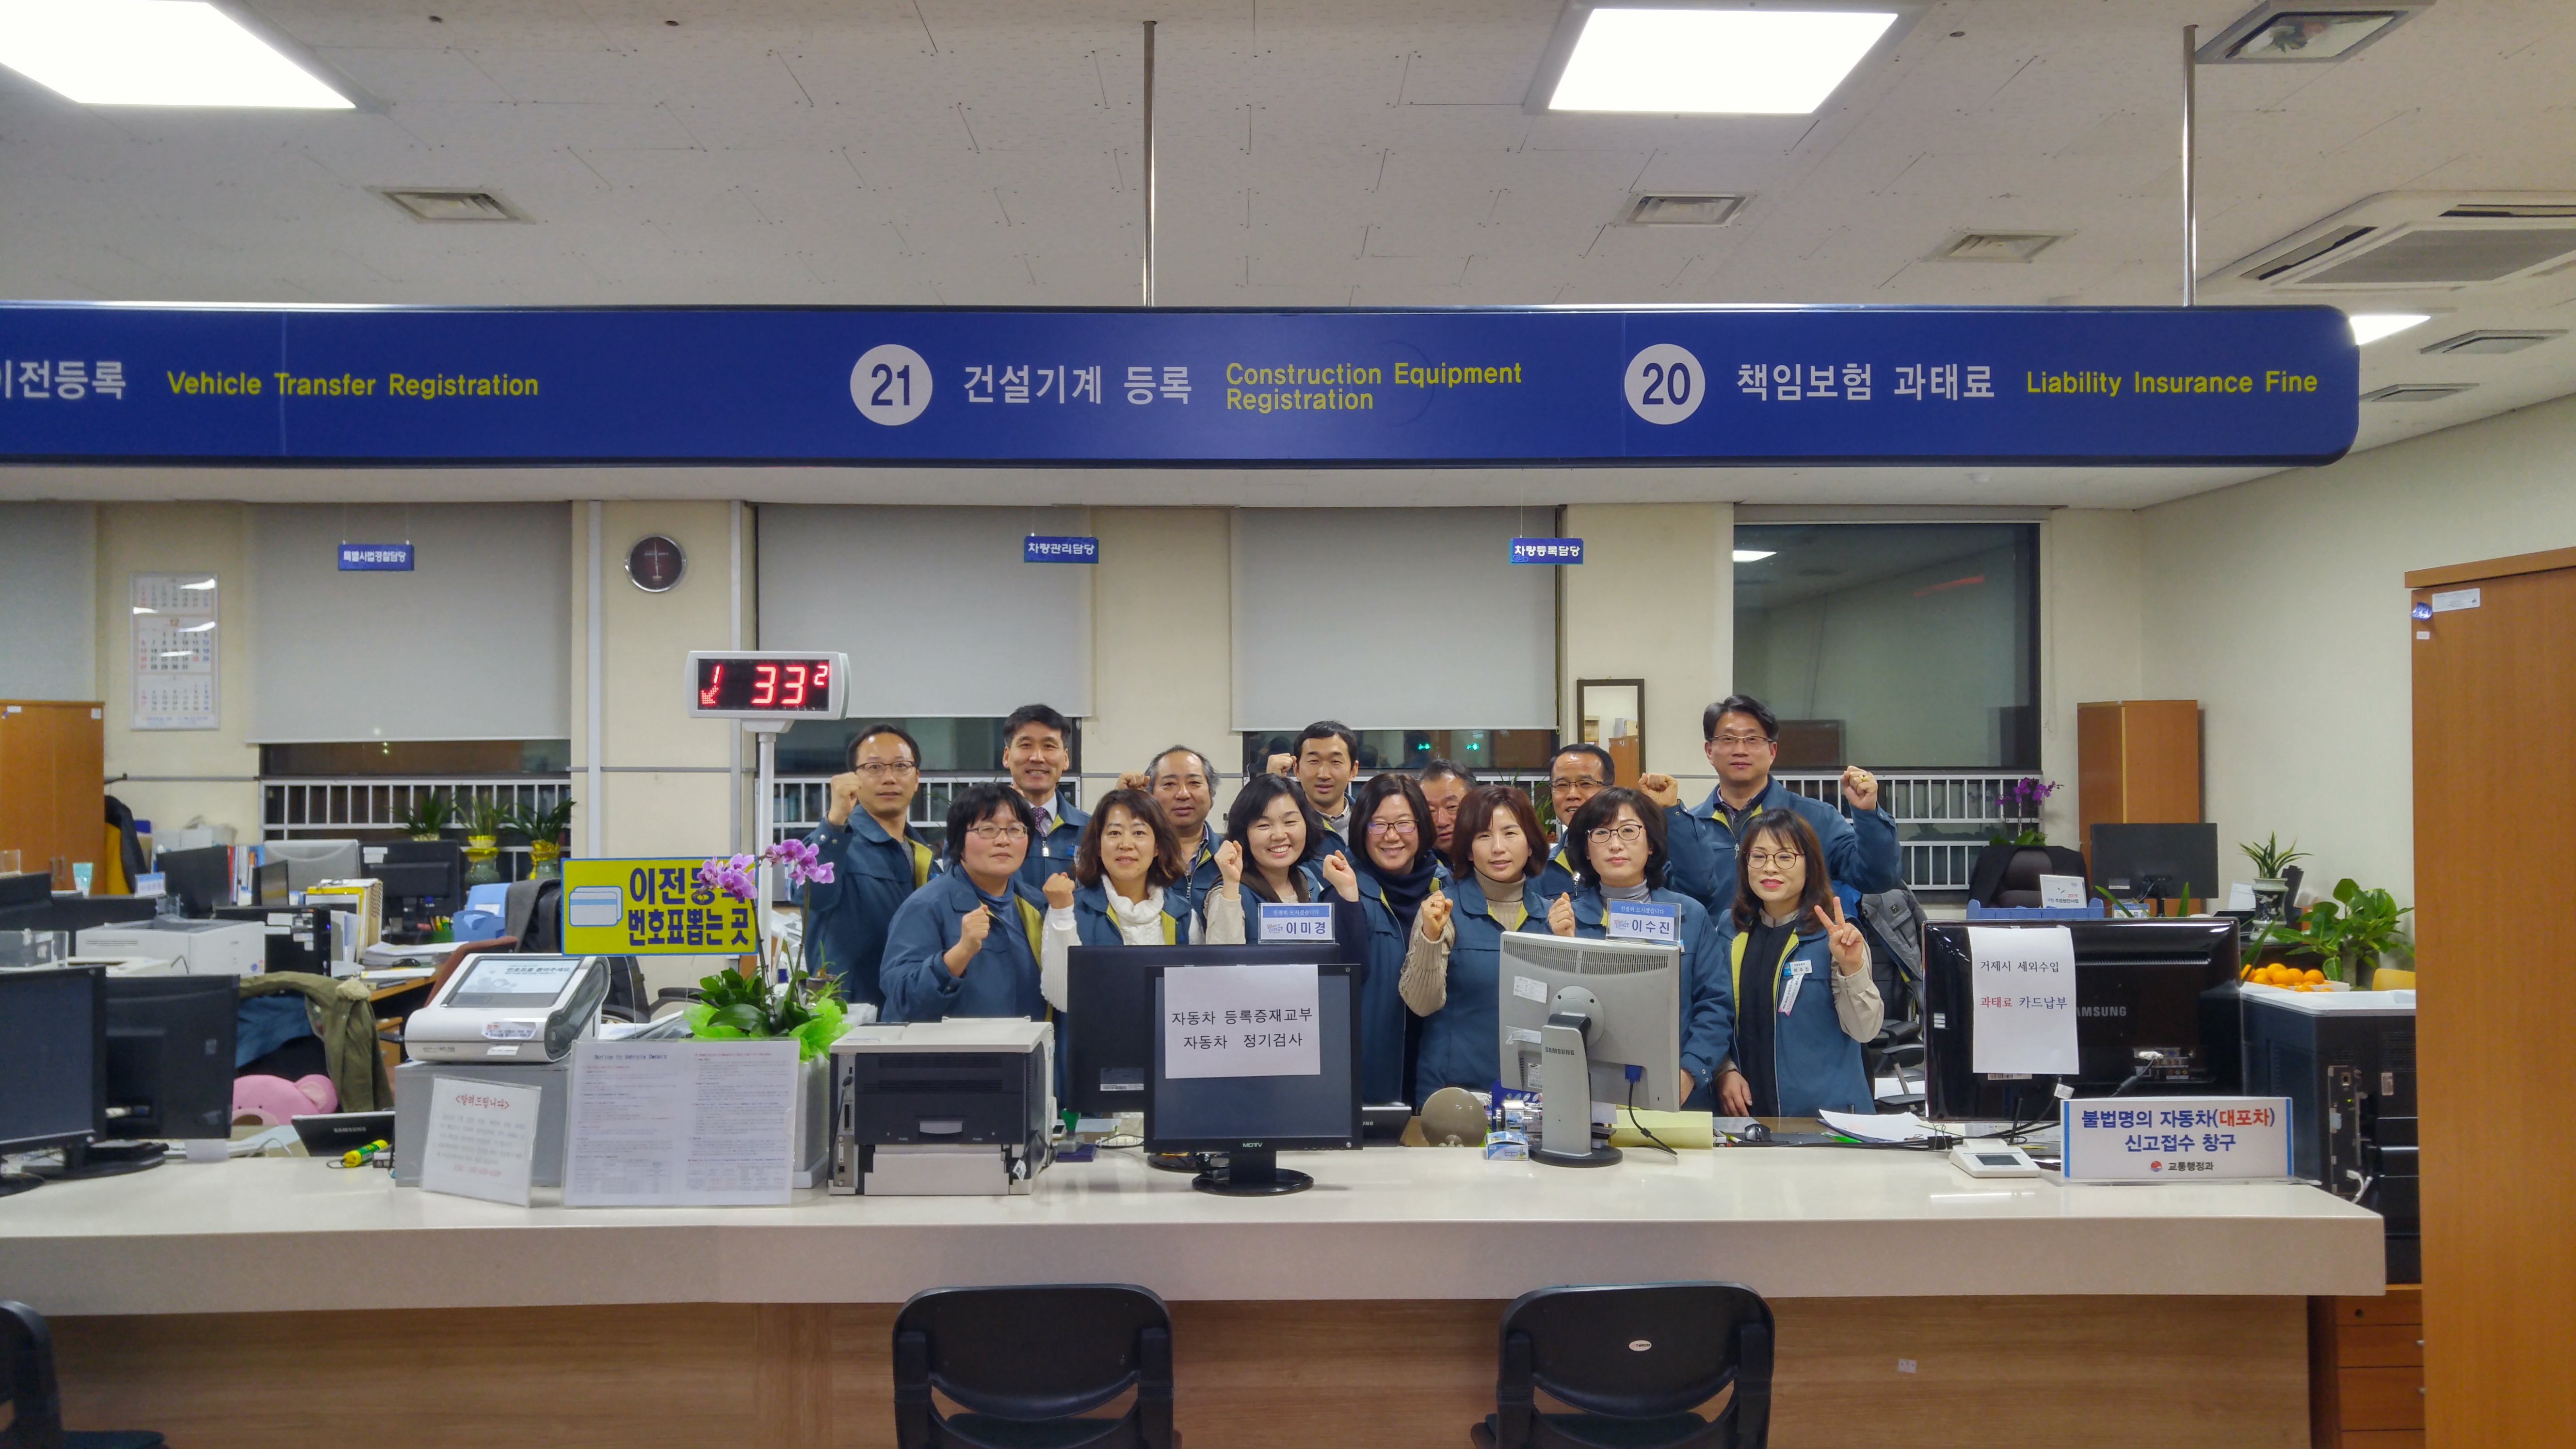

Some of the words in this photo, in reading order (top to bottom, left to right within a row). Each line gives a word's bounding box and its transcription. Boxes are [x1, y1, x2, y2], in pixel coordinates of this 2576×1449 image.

[167, 370, 262, 396] Vehicle
[274, 371, 377, 396] Transfer
[389, 372, 539, 400] Registration
[870, 363, 912, 406] 21
[963, 364, 1103, 405] 건설기계
[1124, 366, 1192, 405] 등록
[1226, 362, 1382, 386] Construction
[1394, 362, 1522, 389] Equipment
[1642, 362, 1690, 405] 20
[1737, 363, 1872, 402] 책임보험
[1894, 363, 1996, 401] 과태료
[2027, 370, 2122, 397] Liability
[2134, 371, 2253, 393] Insurance
[2265, 370, 2318, 392] Fine
[1226, 388, 1373, 414] Registration
[1028, 542, 1095, 556] 차량관리담당
[1514, 545, 1581, 557] 차량등록담당
[713, 665, 721, 684] 1
[751, 666, 806, 704] 33
[813, 665, 828, 685] 2
[630, 868, 746, 905] 이전등
[1636, 907, 1665, 915] 모시겠습니다
[628, 908, 724, 946] 번호표뽑는
[731, 908, 749, 946] 곳
[1286, 922, 1326, 934] 이미경
[1632, 919, 1670, 934] 이수진
[1980, 960, 2011, 972] 거제시
[2017, 961, 2059, 972] 세외수입
[1980, 996, 2013, 1008] 과태료
[2019, 996, 2068, 1010] 카드납부
[2077, 1006, 2126, 1017] MSUNG
[1172, 1011, 1216, 1026] 자동차
[1224, 1008, 1313, 1025] 등록증재교부
[1183, 1034, 1228, 1050] 자동차
[1243, 1032, 1303, 1048] 정기검사
[1545, 1046, 1575, 1056] SAMSUNG
[2081, 1110, 2153, 1128] 불법명의
[2160, 1108, 2275, 1128] 자동차(대포차)
[2125, 1133, 2195, 1152] 신고접수
[2203, 1133, 2236, 1152] 창구
[2168, 1161, 2214, 1172] 교통행정과
